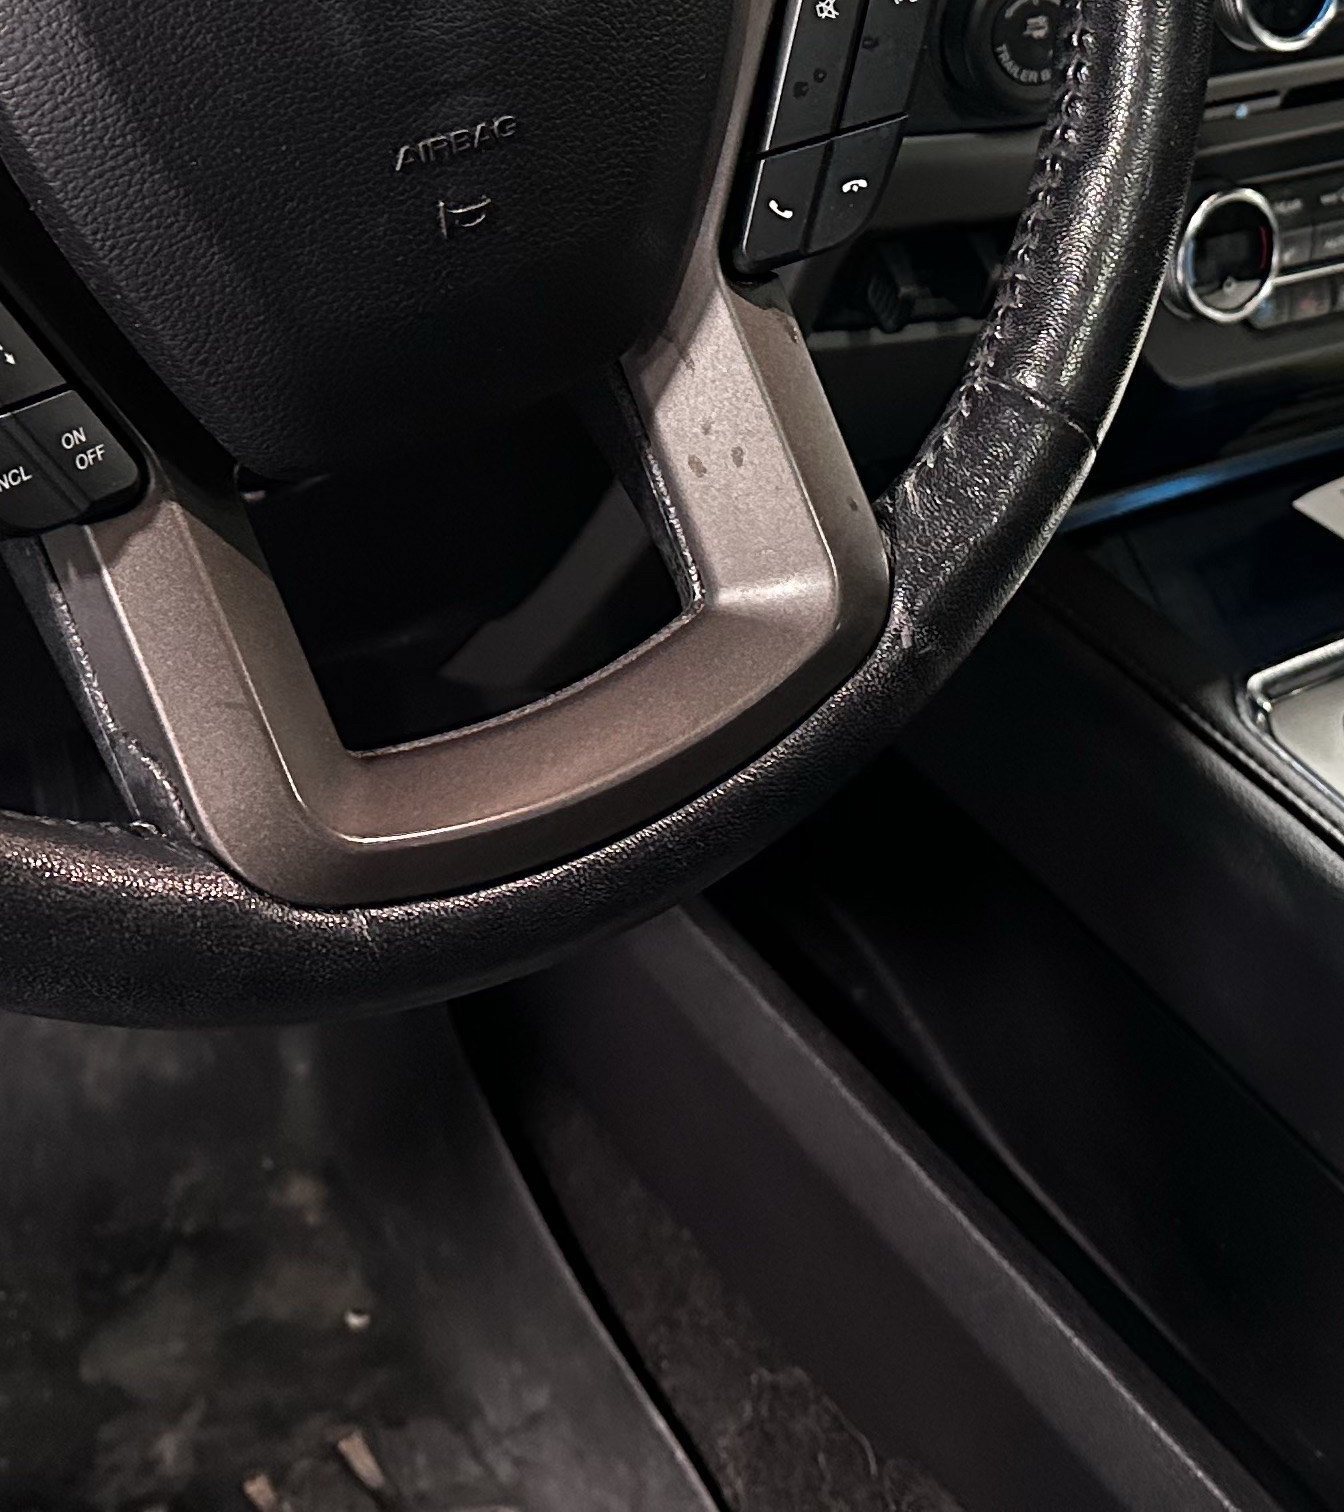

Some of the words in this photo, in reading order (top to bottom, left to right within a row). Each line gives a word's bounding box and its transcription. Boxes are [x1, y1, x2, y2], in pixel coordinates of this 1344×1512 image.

[395, 114, 517, 171] AIRBAG
[61, 426, 87, 451] ON
[74, 443, 106, 471] OFF
